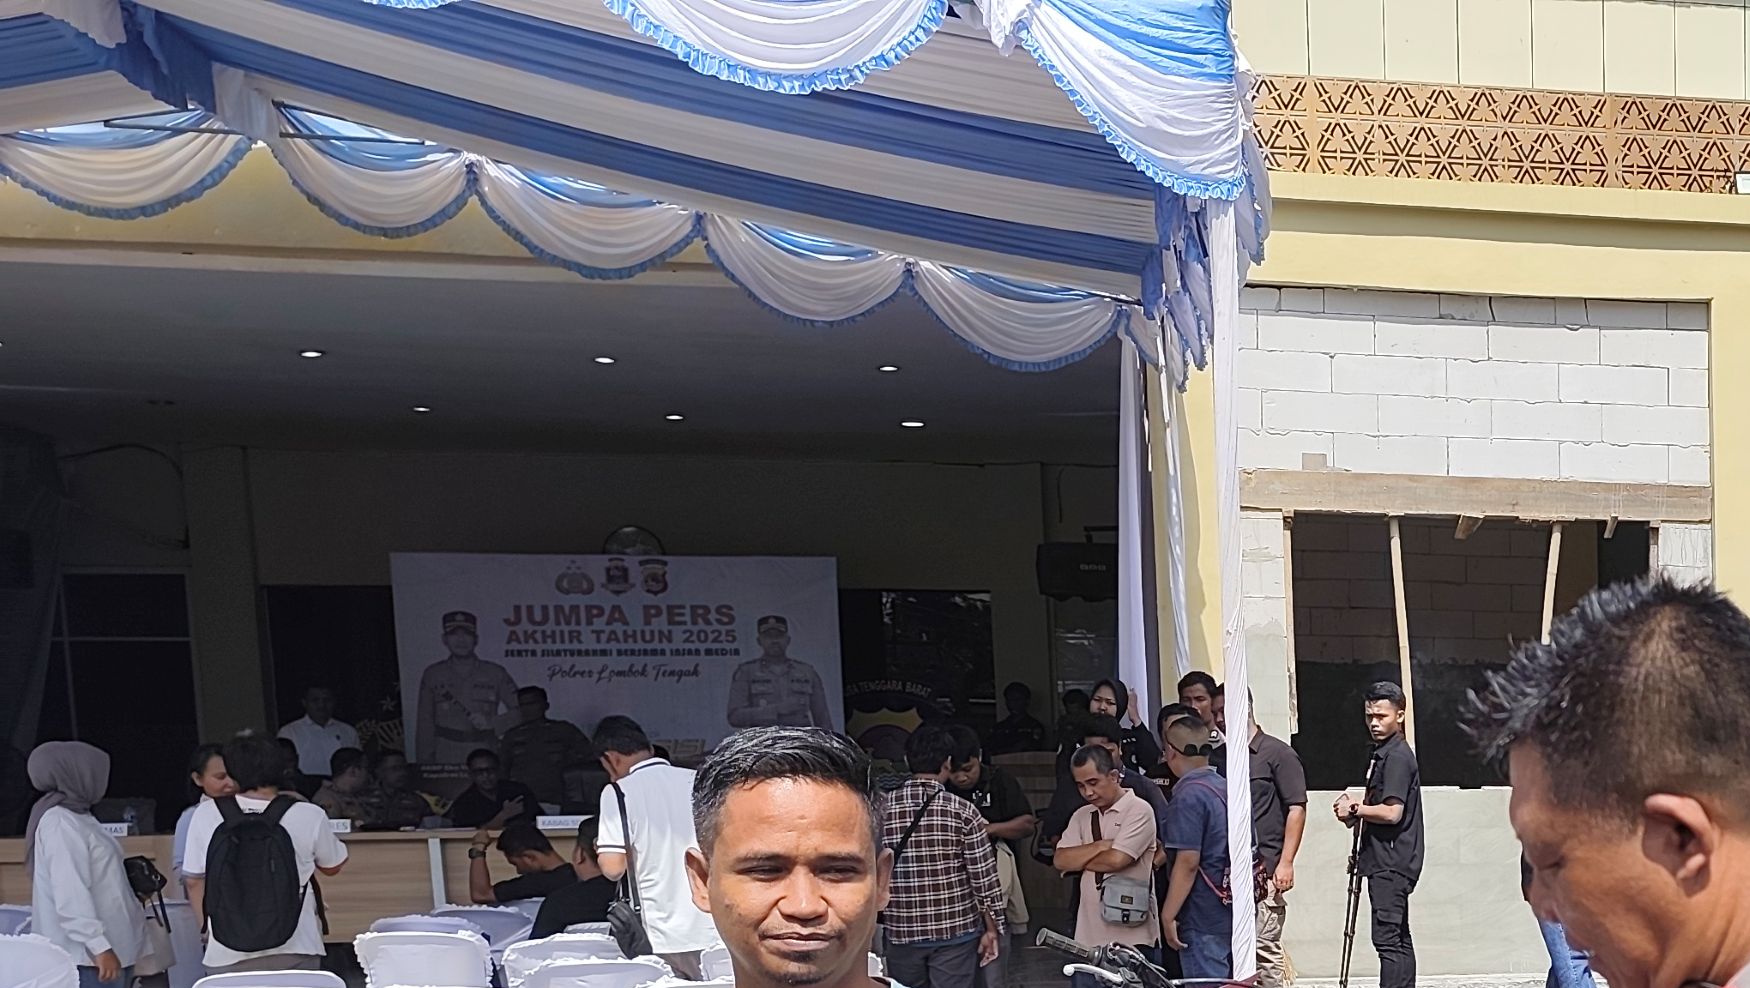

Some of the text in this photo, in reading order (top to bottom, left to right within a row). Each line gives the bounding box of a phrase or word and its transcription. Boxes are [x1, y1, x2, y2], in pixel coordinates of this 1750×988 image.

[503, 604, 736, 627] JUMPA PERS
[506, 629, 737, 645] AKHIR TAHUN 2025
[504, 648, 537, 658] SERTA
[616, 648, 666, 657] BERSAMA
[670, 648, 701, 656] INSAN
[704, 647, 741, 656] MEDIA
[547, 662, 702, 684] Polres Lombok Tengah
